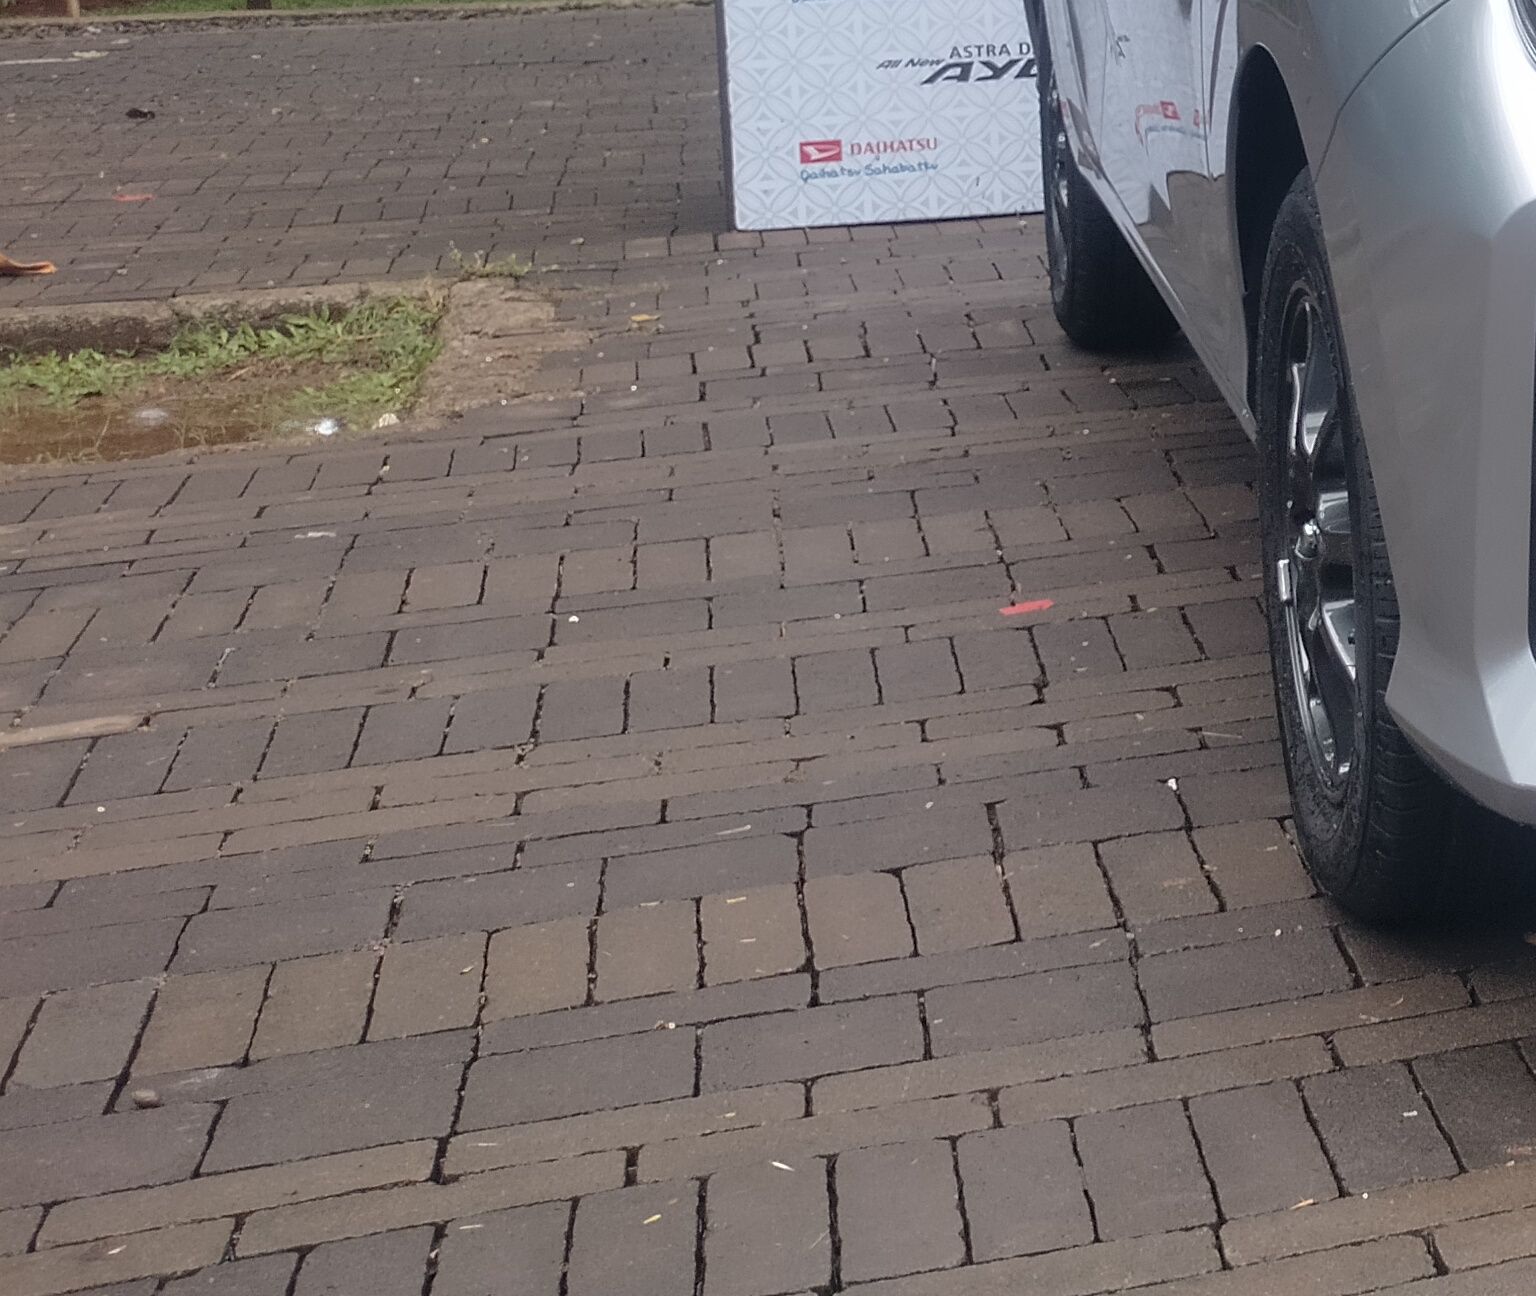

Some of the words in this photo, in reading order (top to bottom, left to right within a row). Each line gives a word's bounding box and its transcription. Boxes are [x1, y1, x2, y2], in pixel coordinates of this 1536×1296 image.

[875, 58, 902, 70] All
[904, 58, 945, 69] New
[949, 44, 1011, 60] ASTRA
[920, 58, 1038, 86] AYL
[850, 137, 938, 156] DAIHATSU
[800, 168, 862, 181] Daihatsu
